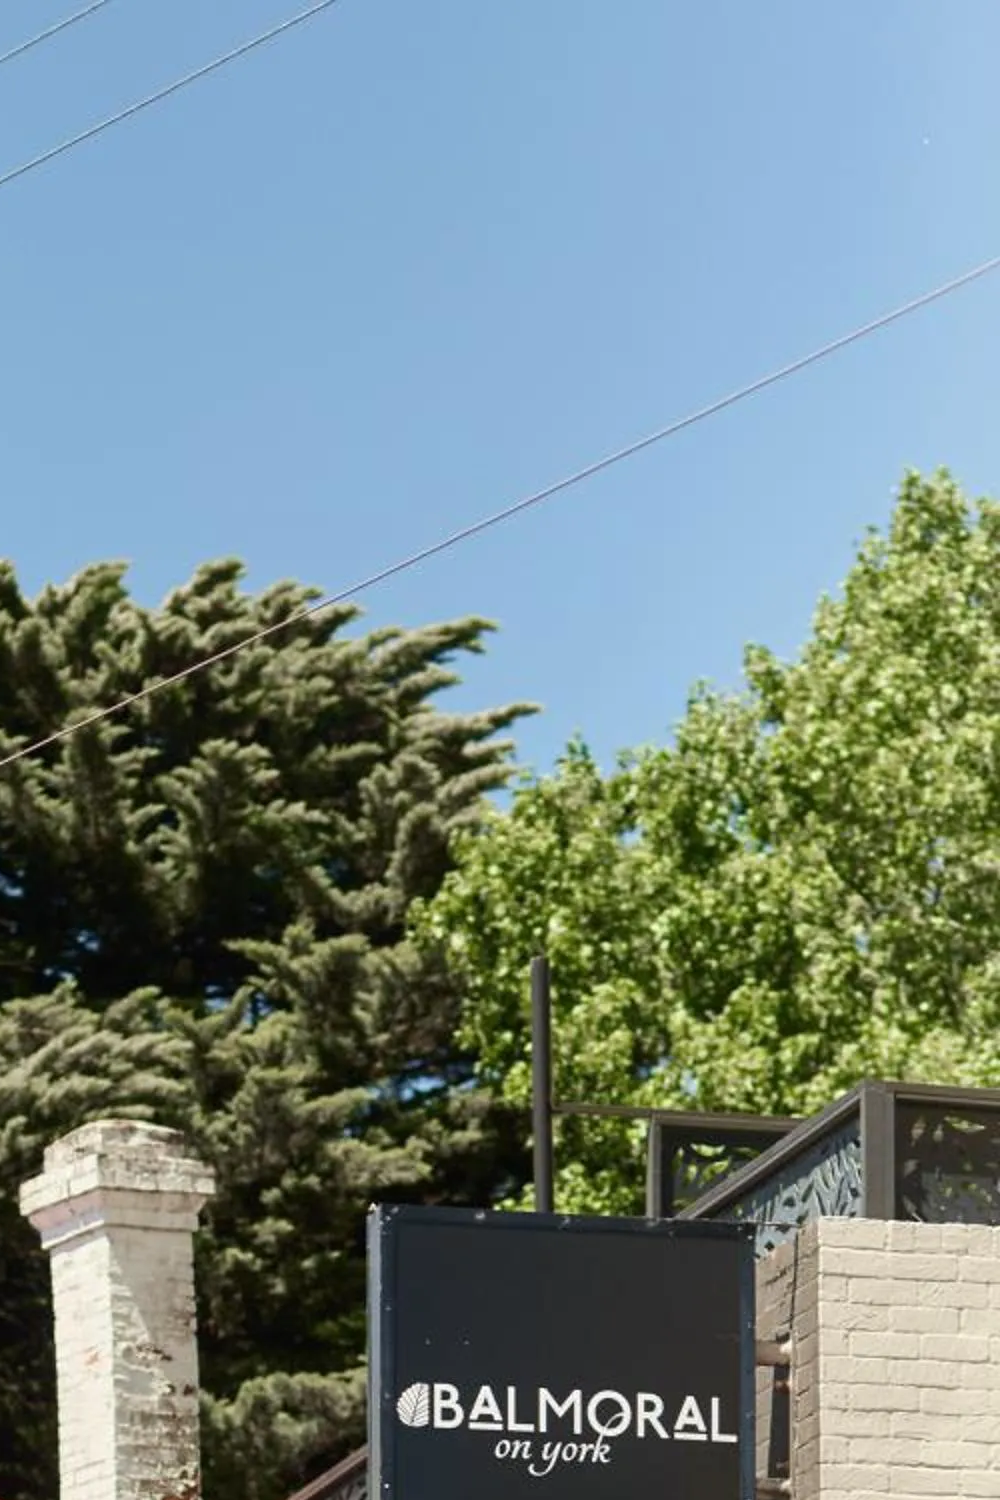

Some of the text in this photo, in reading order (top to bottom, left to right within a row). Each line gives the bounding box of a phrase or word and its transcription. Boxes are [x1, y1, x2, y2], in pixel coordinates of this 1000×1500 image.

[432, 1382, 739, 1444] BALMORAL
[494, 1435, 612, 1477] on york
